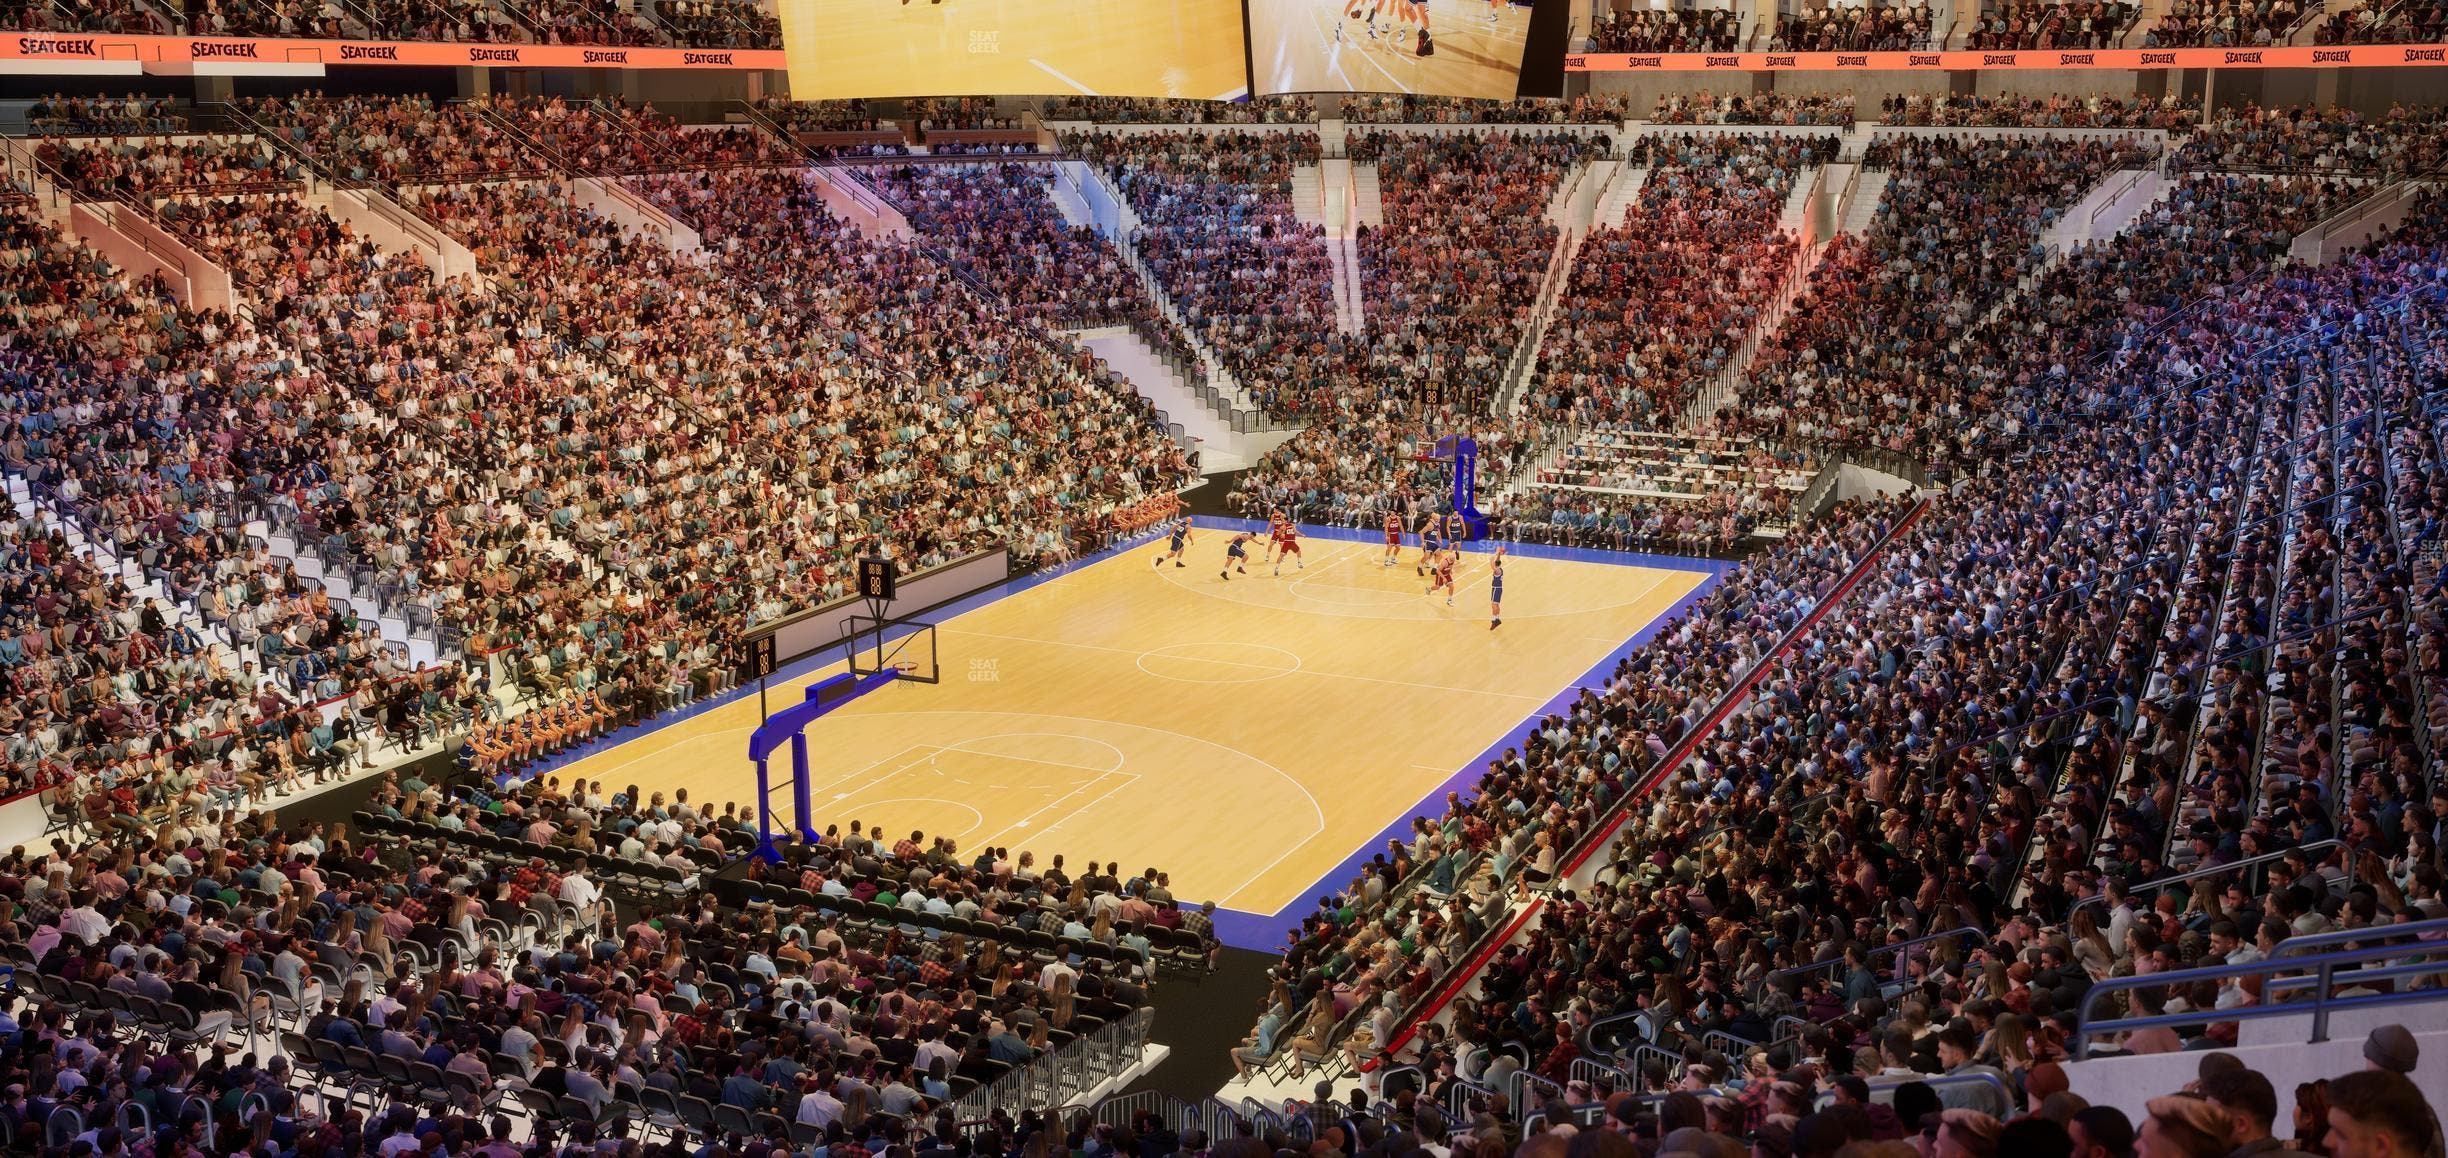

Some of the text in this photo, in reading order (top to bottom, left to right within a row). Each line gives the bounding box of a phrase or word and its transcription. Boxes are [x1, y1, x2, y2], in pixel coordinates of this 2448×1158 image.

[20, 38, 96, 55] SEATGEEK
[191, 42, 258, 58] SEATGEEK
[341, 45, 397, 60] SEATGEEK
[470, 48, 520, 62] SEATGEEK
[584, 50, 627, 64] SEATGEEK
[684, 52, 733, 65] SEATGEEK
[1909, 55, 1941, 66] SEATGEEK
[1983, 55, 2016, 66] SEATGEEK
[2060, 54, 2095, 66] SEATGEEK
[2141, 53, 2176, 65] SEATGEEK
[2225, 52, 2262, 64] SEATGEEK
[2312, 50, 2351, 63] SEATGEEK
[2405, 48, 2446, 62] SEATGEEK
[1565, 57, 1586, 67] TGEEK
[1629, 57, 1662, 67] SEATGEEK
[1706, 57, 1739, 67] SEATGEEK
[1766, 56, 1796, 67] SEATGEEK
[1837, 56, 1868, 67] SEATGEEK
[871, 576, 881, 595] 88
[760, 653, 769, 675] 88
